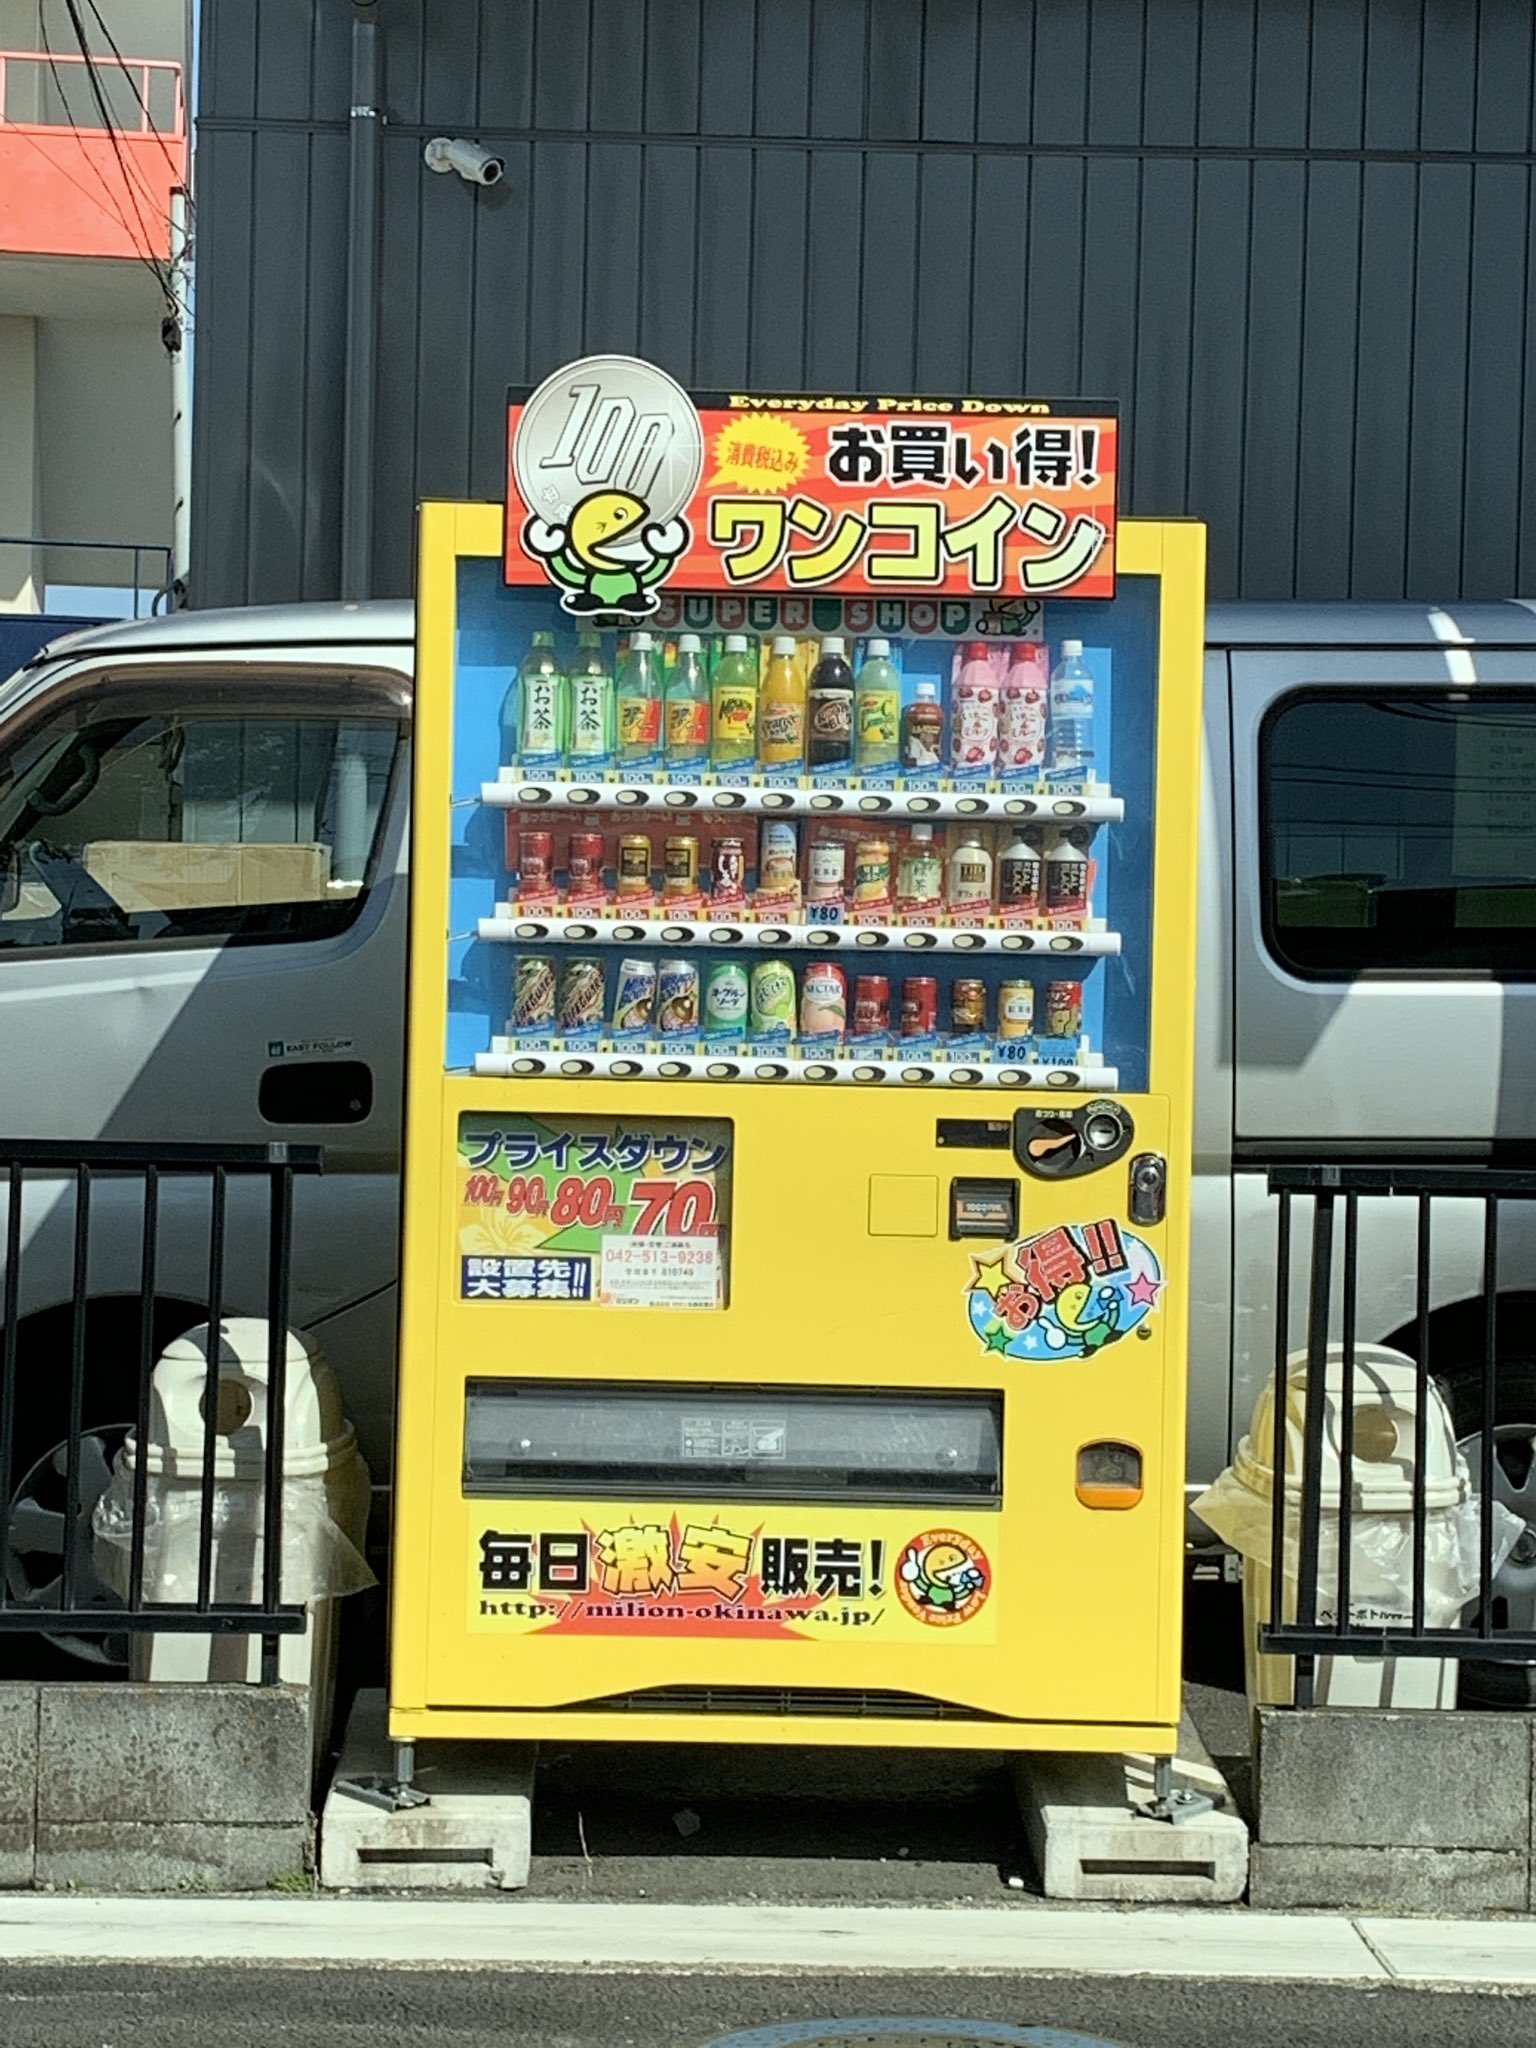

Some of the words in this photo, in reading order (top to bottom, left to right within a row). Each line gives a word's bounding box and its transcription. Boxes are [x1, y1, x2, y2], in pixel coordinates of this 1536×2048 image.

[729, 395, 869, 412] Everyday
[879, 397, 955, 414] Price
[965, 399, 1050, 414] Down
[539, 384, 675, 500] 100
[726, 441, 801, 474] 消費税込み
[710, 497, 1103, 589] ワンコイン
[657, 599, 809, 623] SUPER
[850, 601, 966, 628] SHOP
[532, 685, 553, 730] お茶
[578, 686, 601, 730] お茶
[809, 906, 838, 920] ¥80
[997, 1045, 1026, 1060] ¥80
[465, 1132, 726, 1173] プライスダウン
[467, 1258, 572, 1278] 設置先
[467, 1279, 571, 1298] 大募集
[480, 1600, 886, 1627] http://milion-okinawa.jp/
